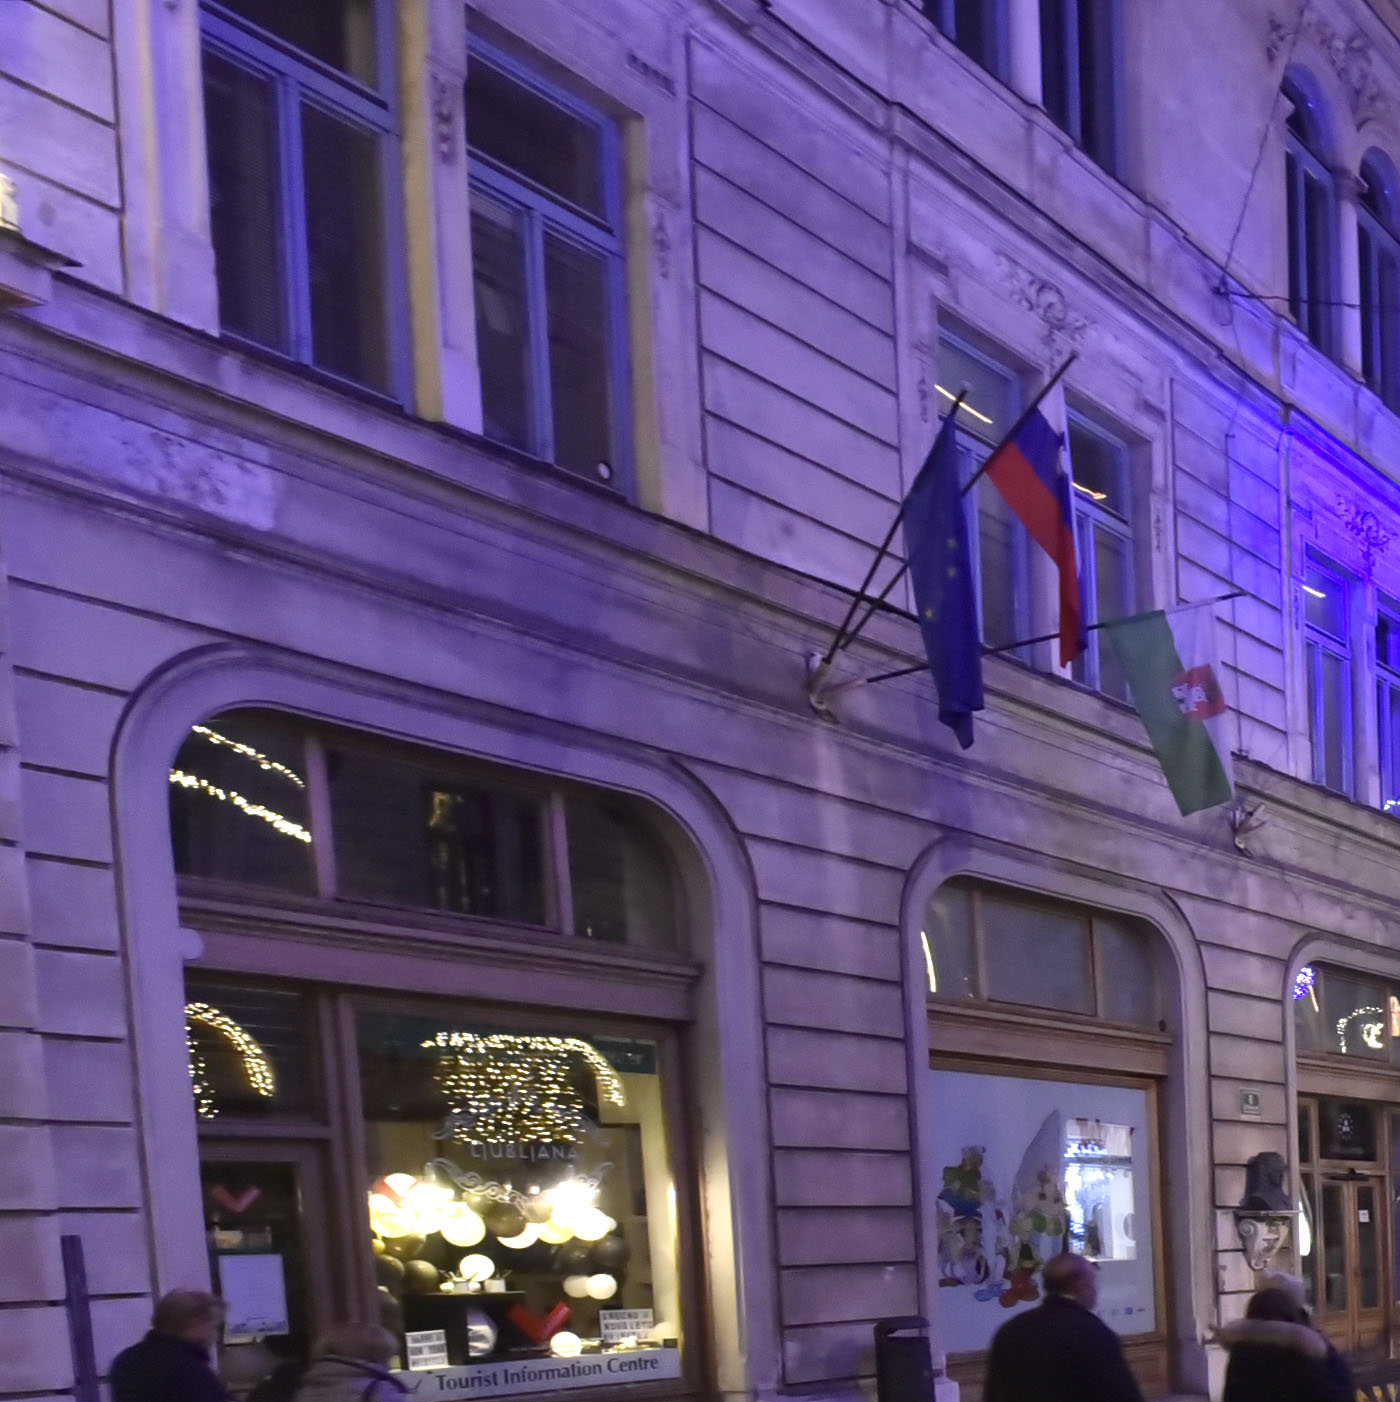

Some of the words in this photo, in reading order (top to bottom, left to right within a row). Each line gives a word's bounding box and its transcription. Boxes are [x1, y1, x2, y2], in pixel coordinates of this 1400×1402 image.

[435, 1372, 499, 1392] Tourist
[503, 1359, 602, 1386] Information
[607, 1356, 659, 1373] Centre
